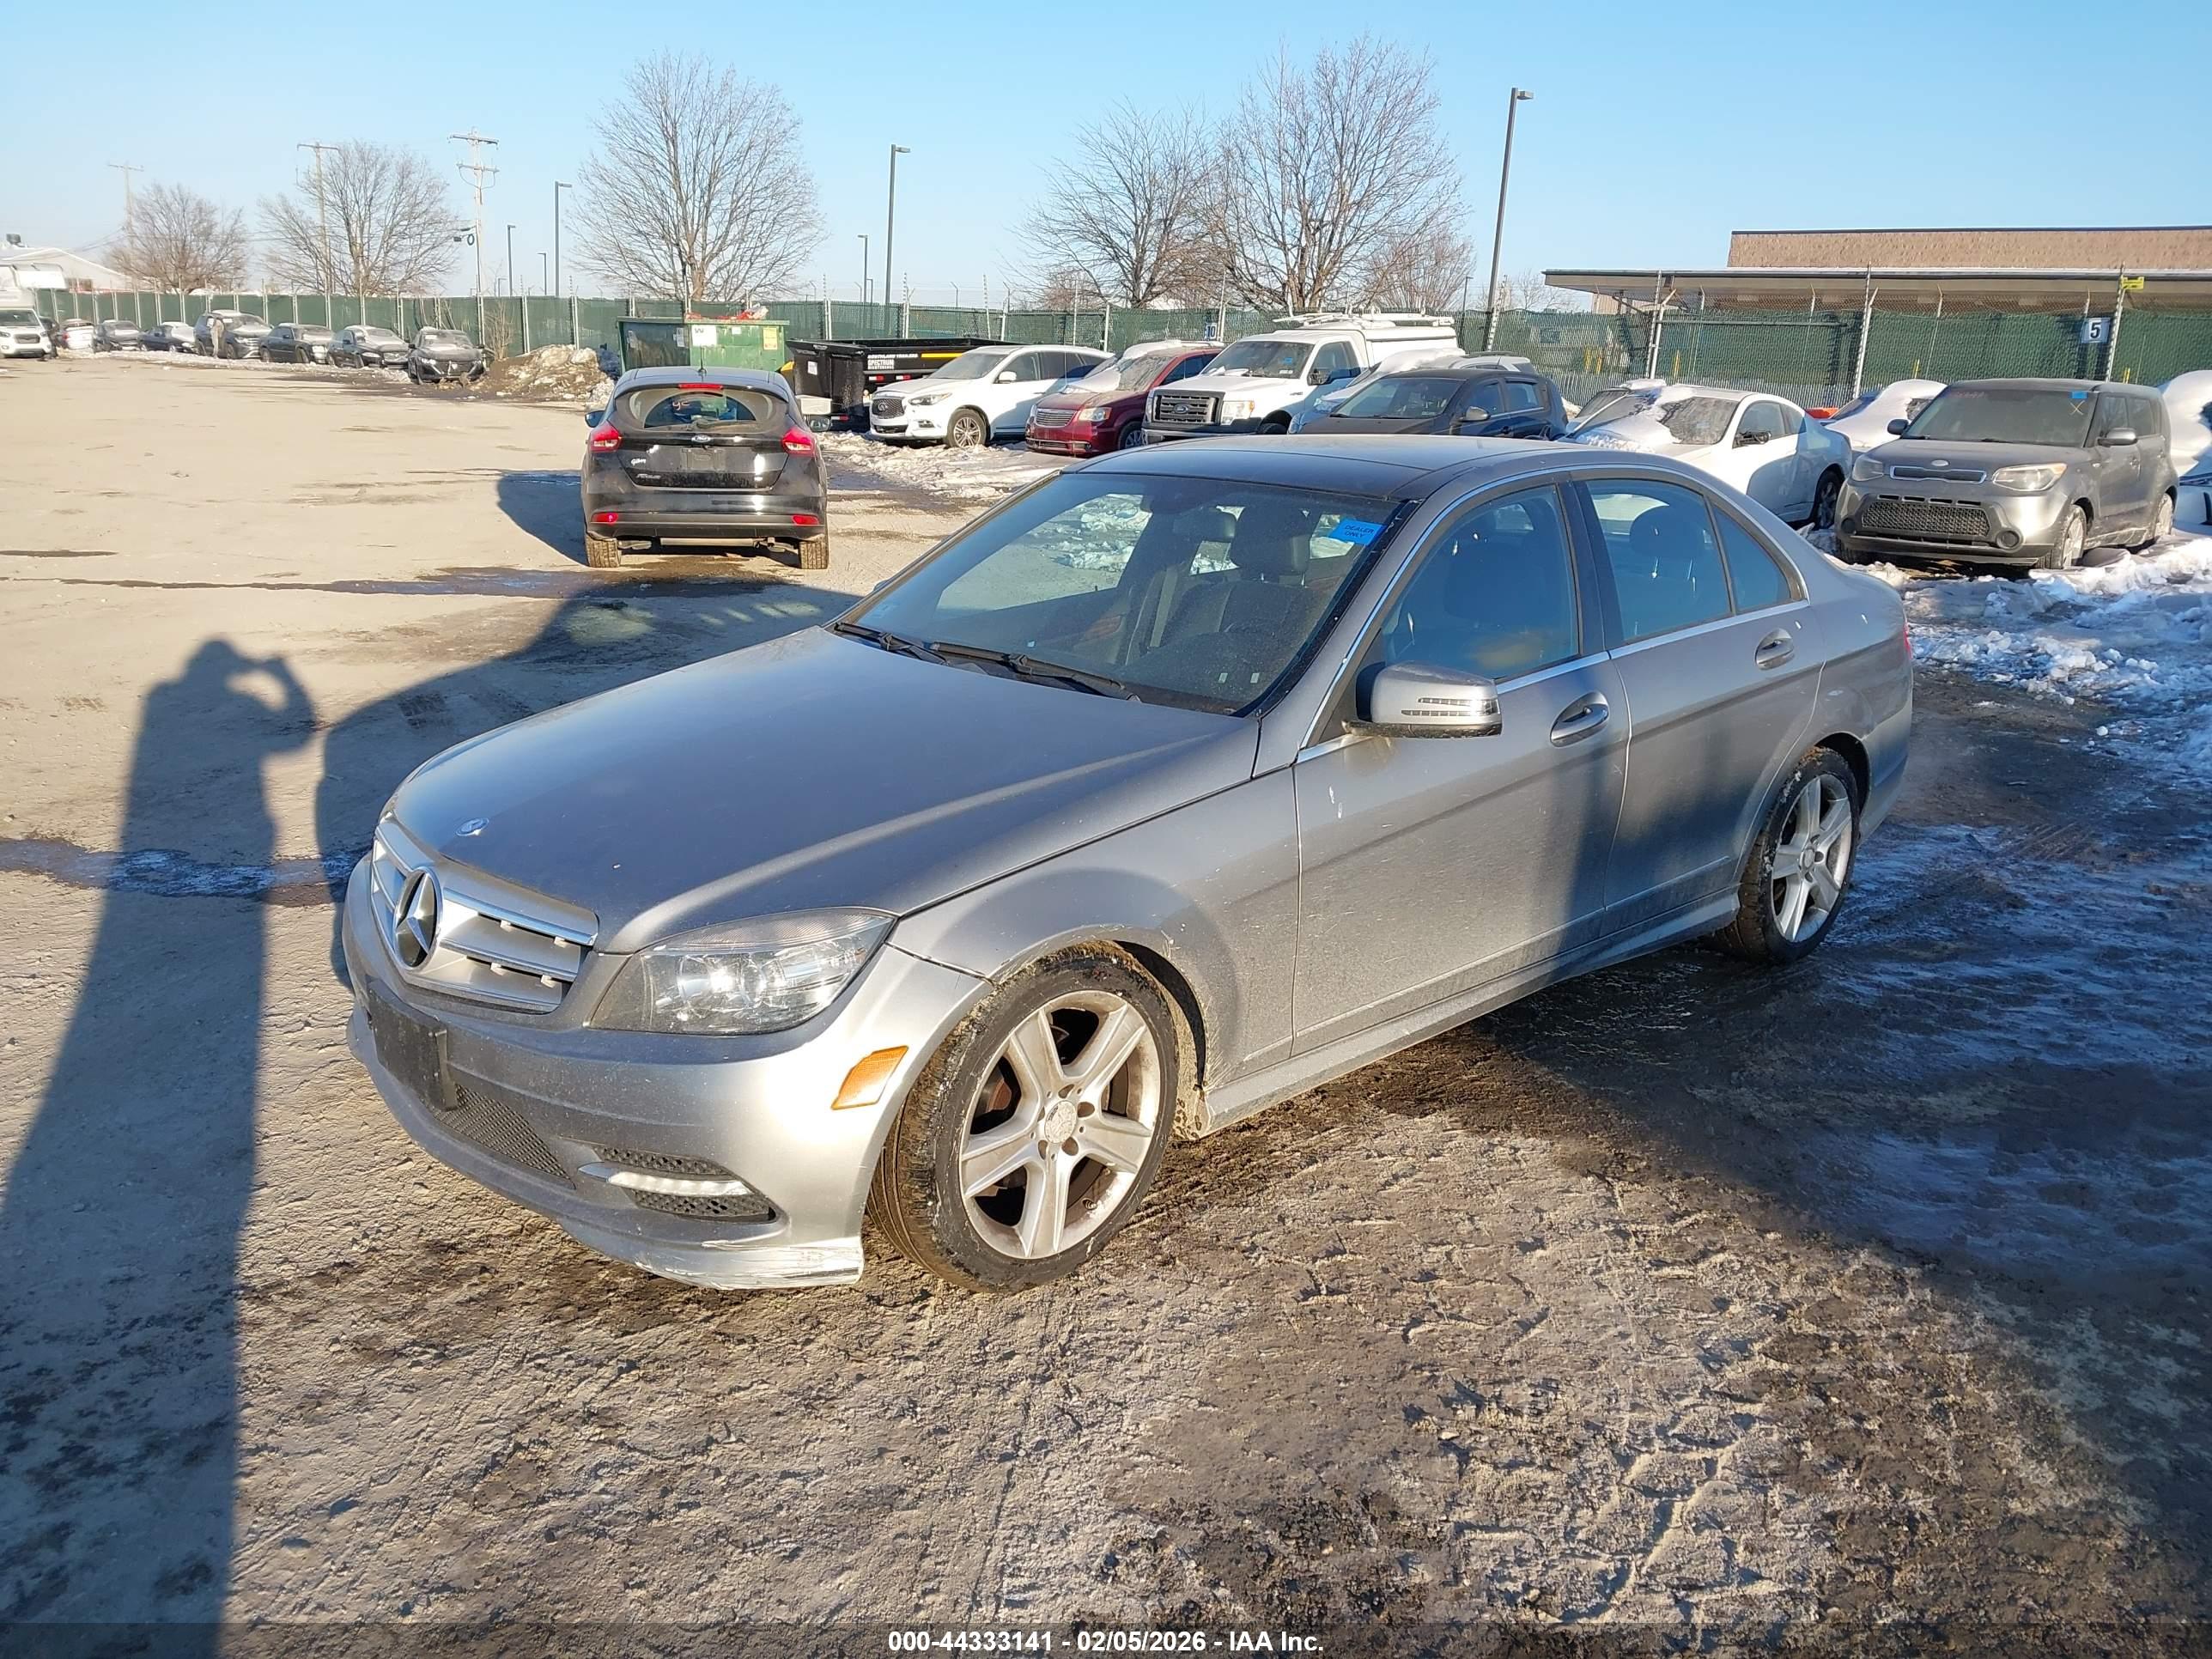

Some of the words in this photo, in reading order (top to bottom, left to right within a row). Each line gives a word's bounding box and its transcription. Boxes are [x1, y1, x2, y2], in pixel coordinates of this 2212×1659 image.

[1206, 325, 1216, 337] 10
[2090, 322, 2101, 338] 5
[1345, 525, 1375, 534] DEALER
